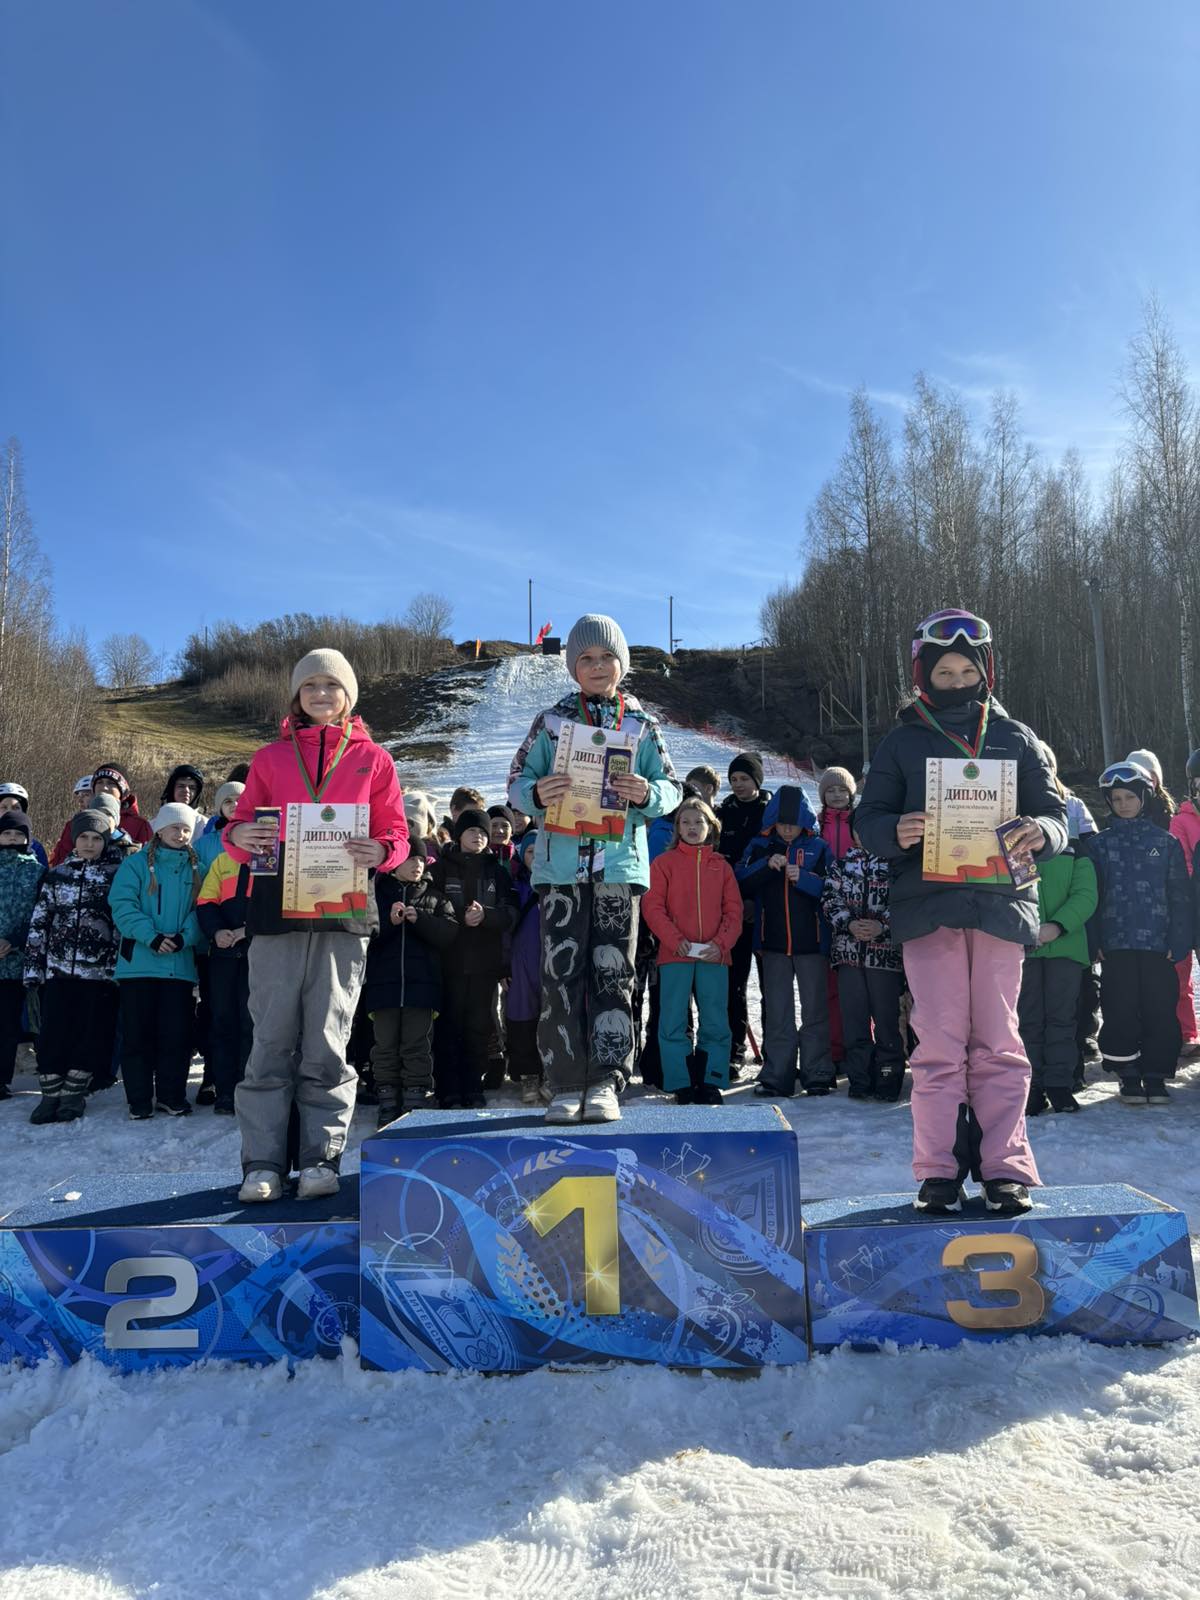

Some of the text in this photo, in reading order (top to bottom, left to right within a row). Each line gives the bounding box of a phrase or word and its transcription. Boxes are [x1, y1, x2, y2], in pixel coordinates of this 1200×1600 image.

[572, 750, 606, 765] ДИПЛ
[610, 757, 628, 766] Alpen
[610, 764, 626, 772] Gold
[945, 788, 997, 802] ДИПЛОМ
[302, 830, 352, 844] ДИПЛОМ
[524, 1176, 620, 1315] 1
[941, 1232, 1045, 1329] 3
[104, 1257, 199, 1349] 2
